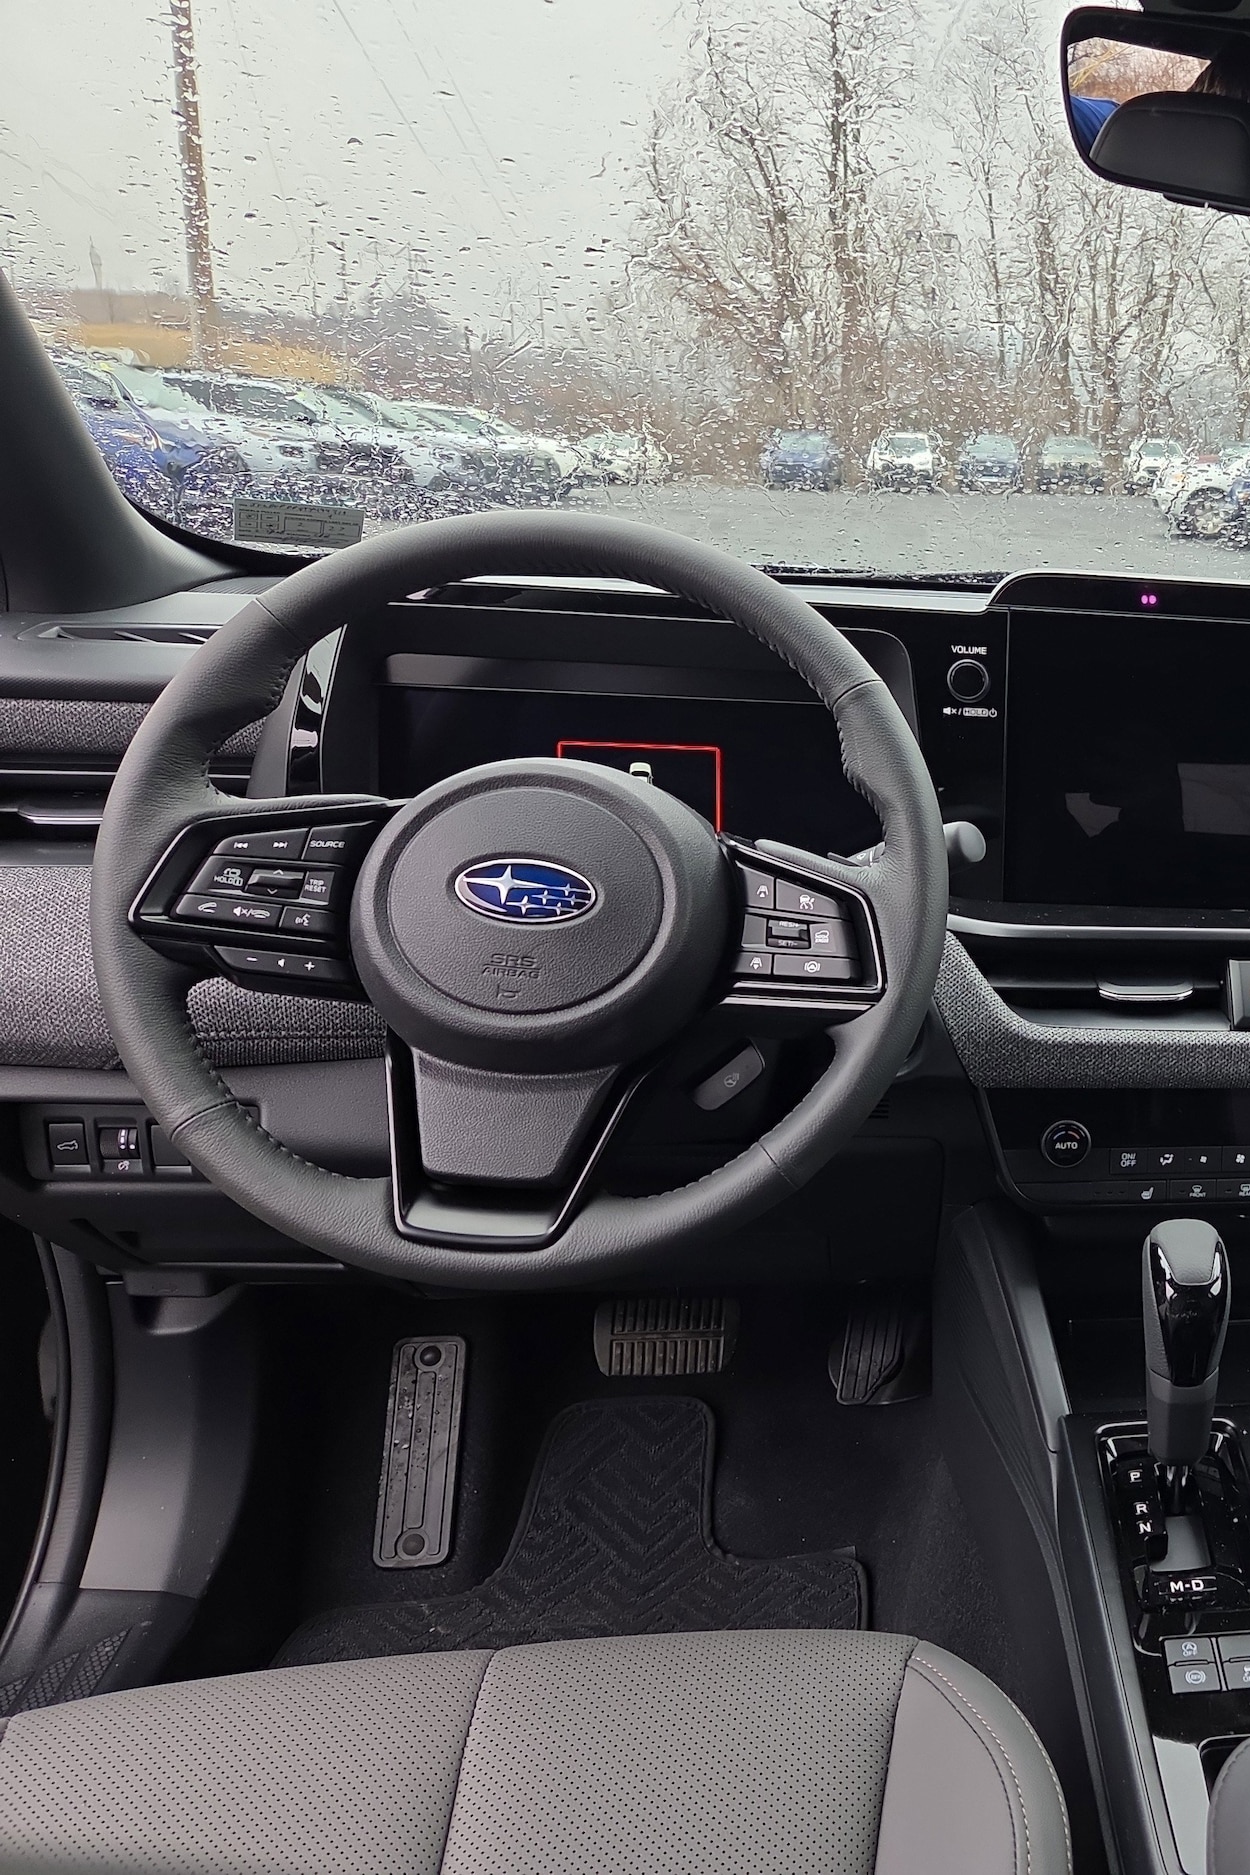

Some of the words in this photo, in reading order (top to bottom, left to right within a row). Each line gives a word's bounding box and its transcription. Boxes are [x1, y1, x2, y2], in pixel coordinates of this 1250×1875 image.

[951, 645, 987, 655] VOLUME
[310, 840, 346, 849] SOURCE
[490, 953, 538, 966] SRS
[482, 967, 540, 979] AIRBAG
[1055, 1142, 1078, 1150] AUTO
[1130, 1472, 1141, 1482] P
[1136, 1504, 1148, 1515] R
[1139, 1522, 1151, 1533] N
